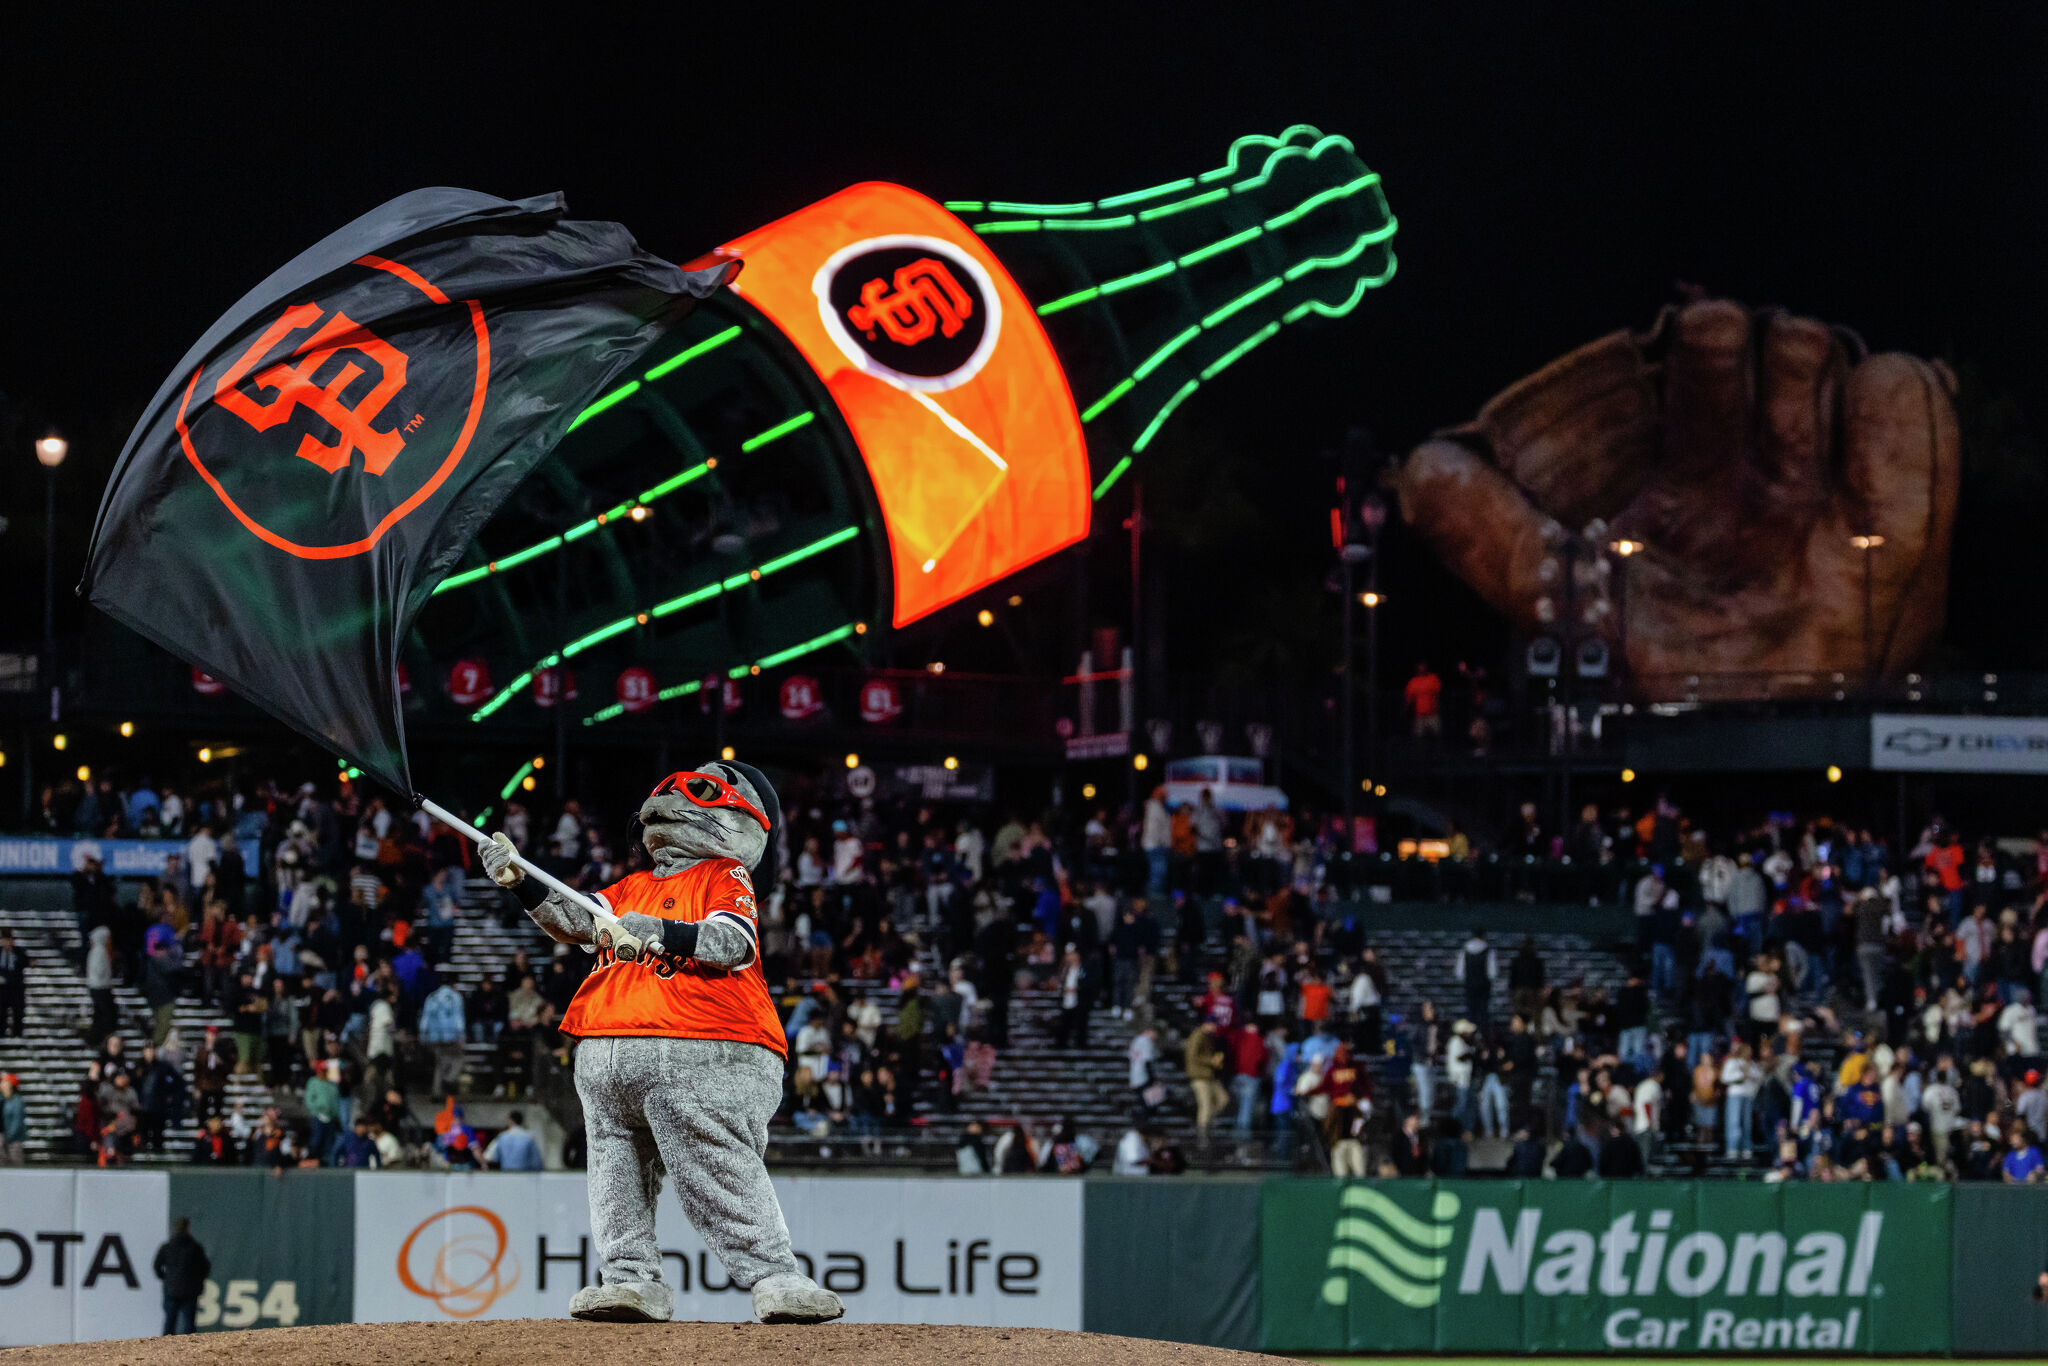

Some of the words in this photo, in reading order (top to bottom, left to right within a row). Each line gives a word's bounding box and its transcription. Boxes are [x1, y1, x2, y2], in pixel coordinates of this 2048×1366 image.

[403, 413, 425, 433] TM
[0, 1230, 140, 1288] OTA
[896, 1238, 1040, 1295] Life
[1459, 1208, 1883, 1297] National
[1603, 1308, 1689, 1350] Car
[1699, 1309, 1861, 1350] Rental
